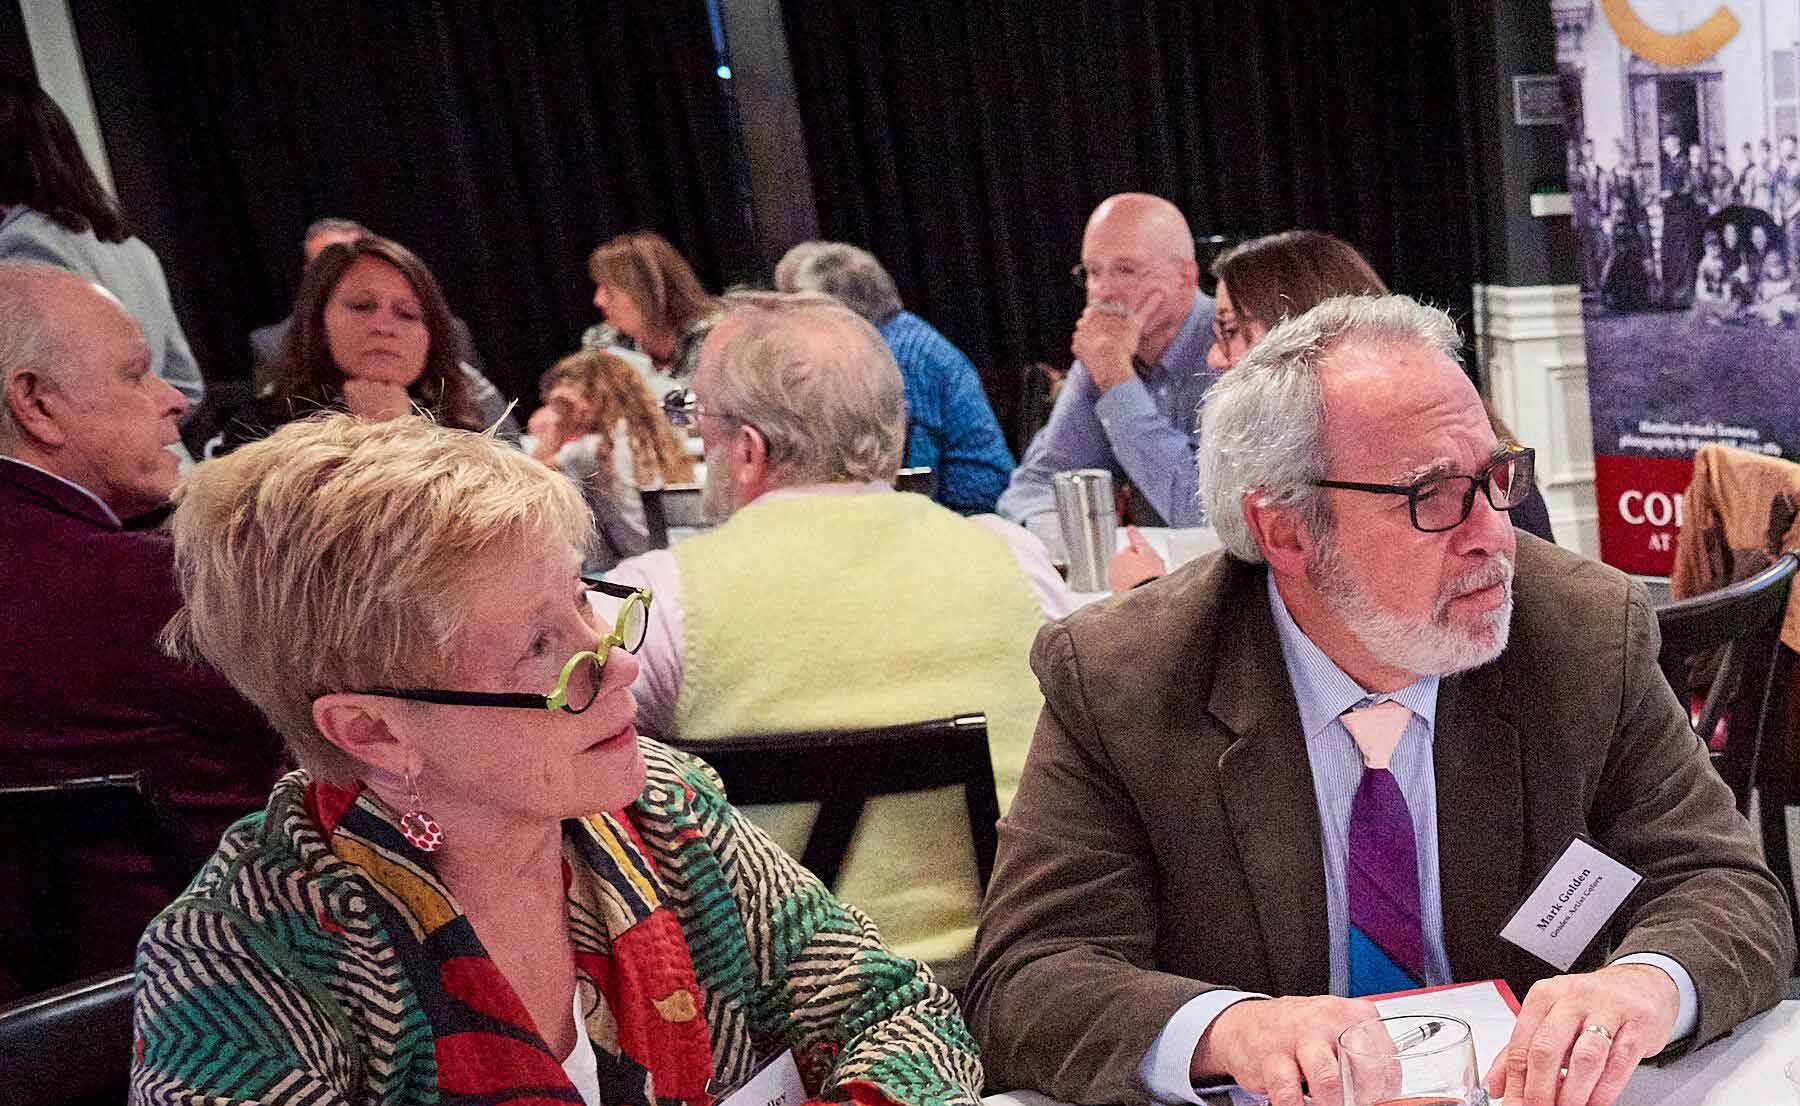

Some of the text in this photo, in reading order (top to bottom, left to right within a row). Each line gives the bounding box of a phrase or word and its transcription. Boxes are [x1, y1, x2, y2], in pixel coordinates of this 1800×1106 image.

[1536, 869, 1591, 931] Mark Golden
[1569, 896, 1586, 916] Artist
